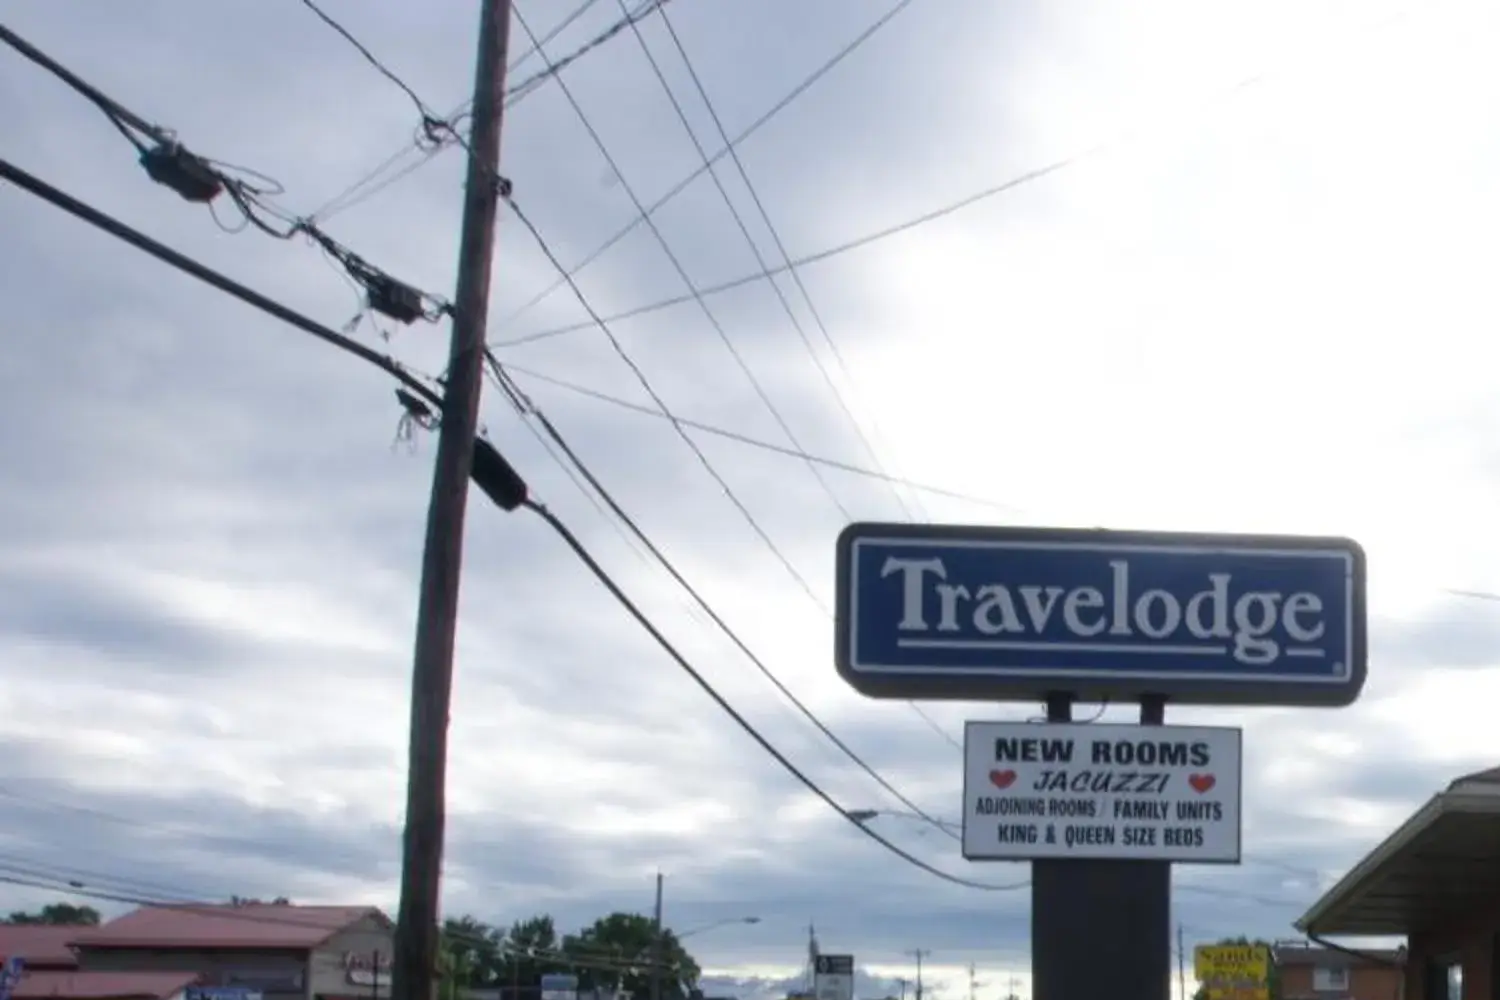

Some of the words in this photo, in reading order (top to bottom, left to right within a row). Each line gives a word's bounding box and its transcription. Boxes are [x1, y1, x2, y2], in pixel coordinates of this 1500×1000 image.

[881, 556, 1325, 665] Travelodge
[995, 738, 1074, 764] NEW
[1091, 740, 1210, 767] ROOMS
[1033, 770, 1171, 794] JACUZZI
[975, 797, 1045, 817] ADJOINING
[1048, 799, 1097, 818] ROOMS
[1113, 801, 1169, 821] FAMILY
[1176, 801, 1222, 821] UNITS
[997, 824, 1038, 844] KING
[1045, 827, 1056, 845] &
[1065, 826, 1114, 847] QUEEN
[1122, 827, 1156, 846] SIZE
[1163, 828, 1204, 848] BEDS
